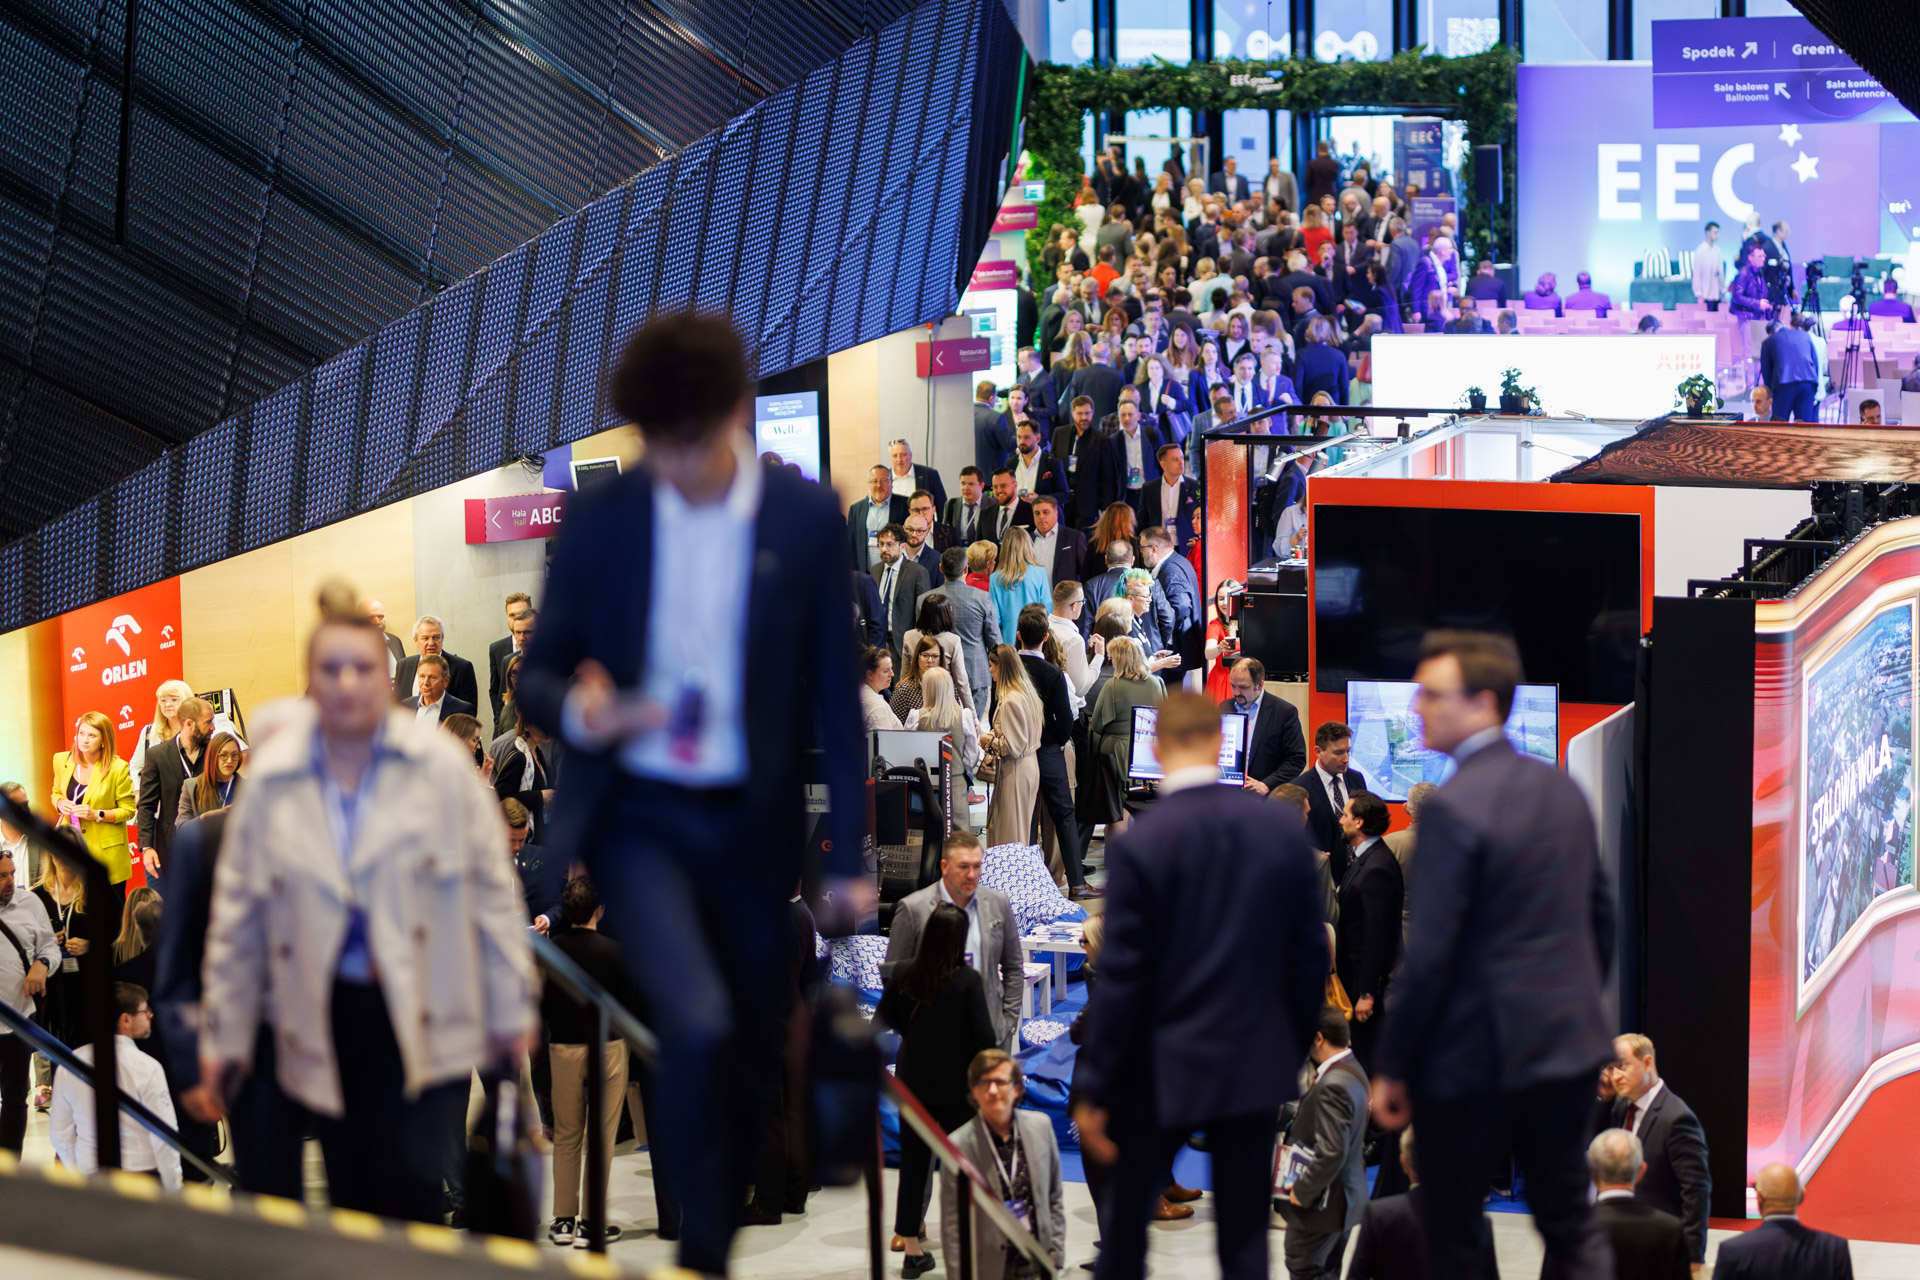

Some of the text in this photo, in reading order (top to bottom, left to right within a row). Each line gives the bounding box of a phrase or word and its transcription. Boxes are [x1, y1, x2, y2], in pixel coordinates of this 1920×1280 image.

[1682, 46, 1735, 61] Spodek
[1792, 43, 1835, 56] Green
[1714, 82, 1770, 92] Sale balowe
[1826, 80, 1846, 89] Sale
[1725, 92, 1770, 102] Ballrooms
[1834, 89, 1886, 99] Conference
[1410, 130, 1434, 144] EEC
[1597, 143, 1755, 222] EEC
[1657, 353, 1702, 370] ABB
[511, 506, 562, 526] Hala ABC
[514, 518, 527, 527] Hall
[160, 639, 176, 650] ORLEN
[70, 662, 88, 672] ORLEN
[102, 659, 147, 686] ORLEN
[118, 720, 135, 730] ORLEN
[887, 774, 921, 783] BRIDE
[1812, 733, 1892, 845] STALOWA WOLA
